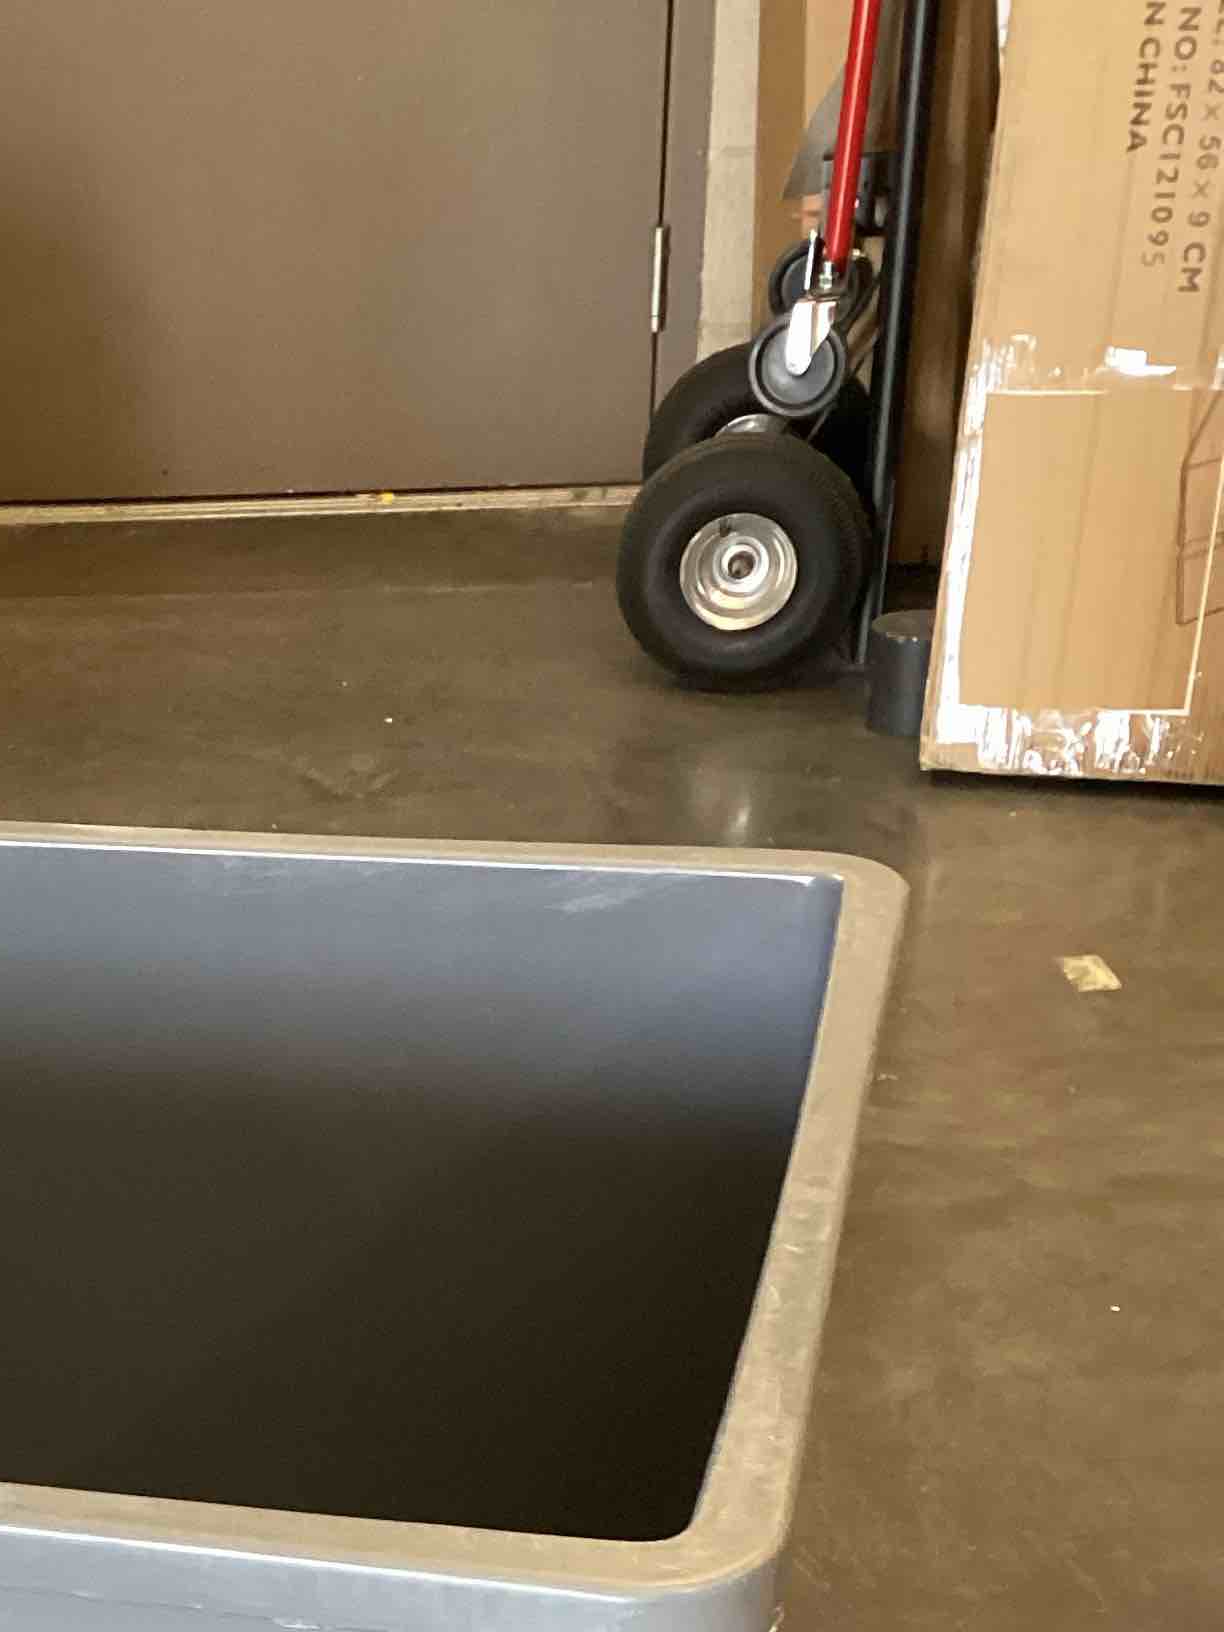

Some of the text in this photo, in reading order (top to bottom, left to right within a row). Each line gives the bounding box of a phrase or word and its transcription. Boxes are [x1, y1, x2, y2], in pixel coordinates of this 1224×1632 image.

[1126, 37, 1161, 152] CHINA
[1196, 135, 1222, 169] 56
[1187, 210, 1211, 228] 9
[1178, 241, 1207, 293] CM
